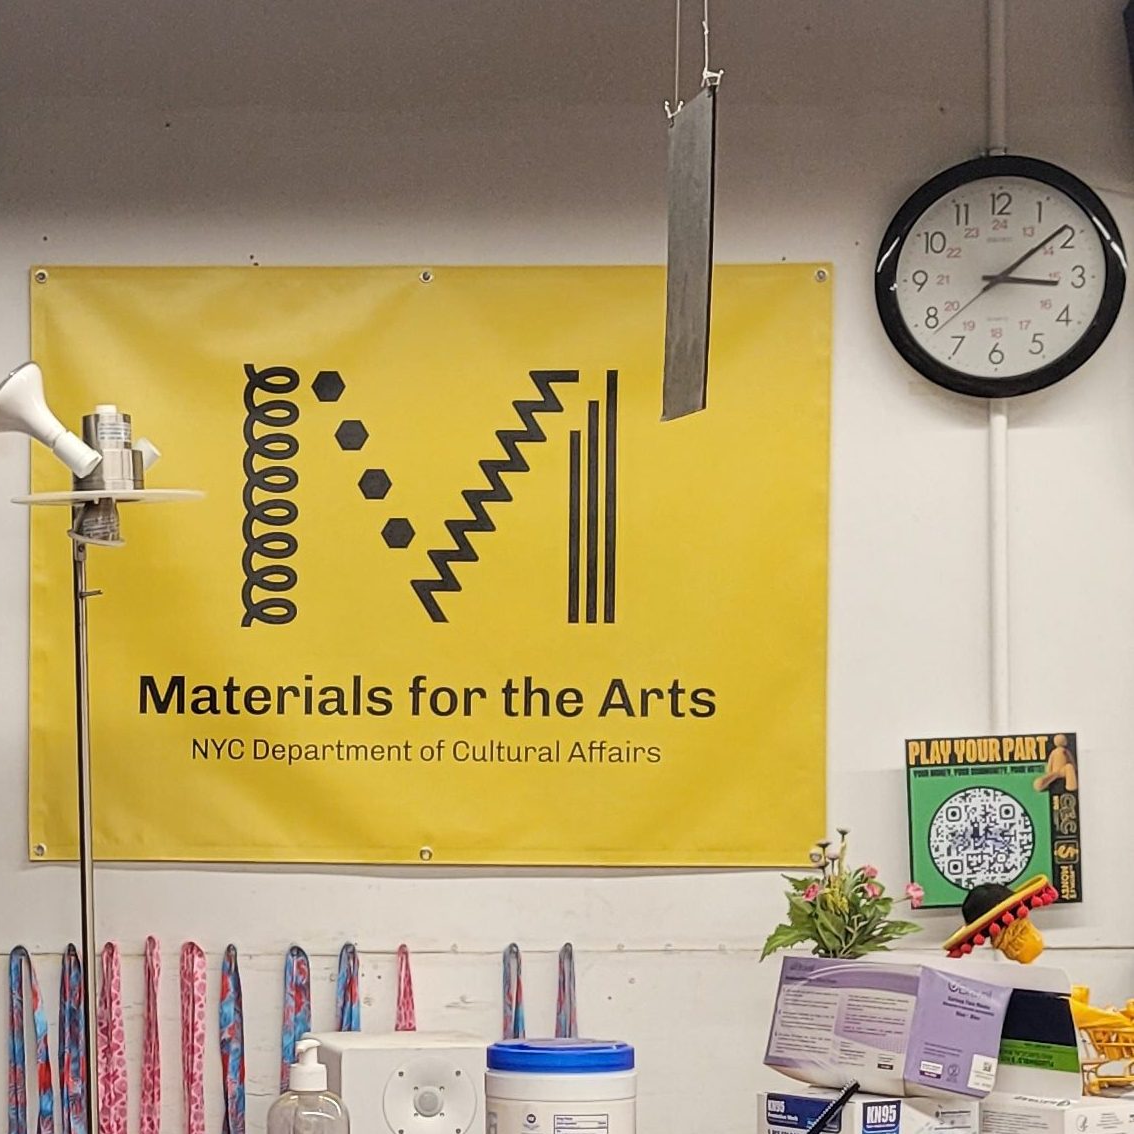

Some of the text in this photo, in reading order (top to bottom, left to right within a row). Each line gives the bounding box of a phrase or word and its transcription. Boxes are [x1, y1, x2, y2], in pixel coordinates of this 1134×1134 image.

[954, 203, 969, 226] 11
[990, 192, 1012, 216] 12
[1036, 201, 1042, 223] 1
[964, 227, 979, 239] 23
[992, 219, 1008, 231] 24
[1022, 226, 1035, 237] 13
[924, 231, 946, 254] 10
[1059, 224, 1075, 249] 2
[946, 247, 962, 259] 22
[912, 270, 928, 293] 9
[936, 274, 950, 285] 21
[1070, 264, 1085, 289] 3
[944, 300, 960, 312] 20
[1055, 303, 1072, 327] 4
[925, 306, 939, 329] 8
[963, 320, 975, 331] 19
[1018, 319, 1032, 331] 17
[950, 335, 966, 356] 7
[988, 342, 1004, 365] 6
[1028, 333, 1044, 355] 5
[139, 674, 716, 718] Materials for the Arts
[192, 738, 662, 765] NYC Department of Cultural Affairs
[908, 735, 1048, 765] PLAY YOUR PART
[866, 1104, 897, 1125] KN95
